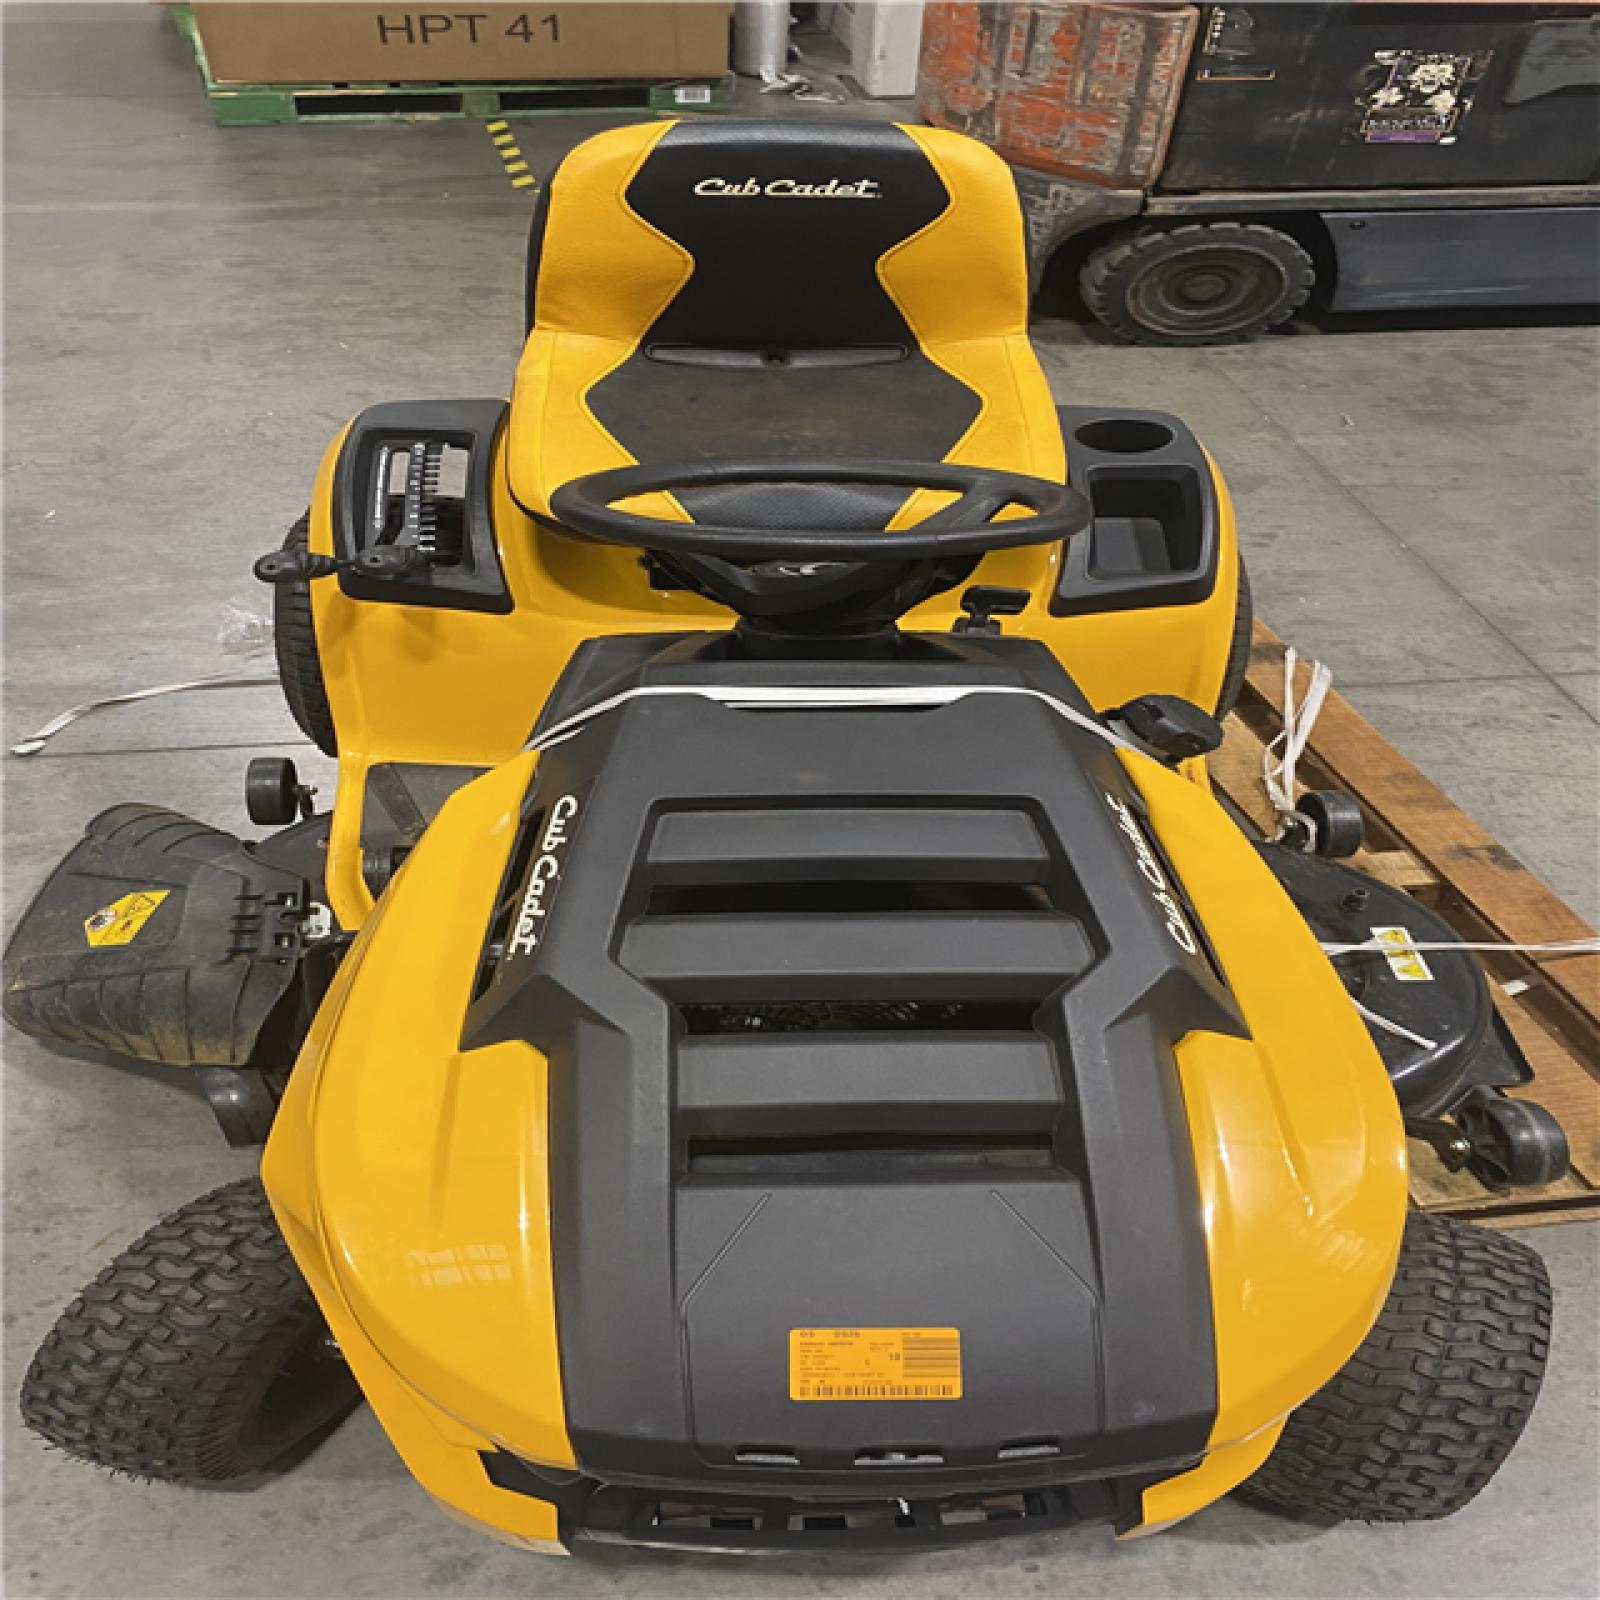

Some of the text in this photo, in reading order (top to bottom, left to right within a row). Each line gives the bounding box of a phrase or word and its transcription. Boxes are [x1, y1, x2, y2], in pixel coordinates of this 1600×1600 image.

[377, 13, 560, 44] HPT 41
[694, 177, 880, 198] Cub Cadet
[508, 794, 579, 957] Cub Cadet
[1152, 890, 1197, 955] Cub
